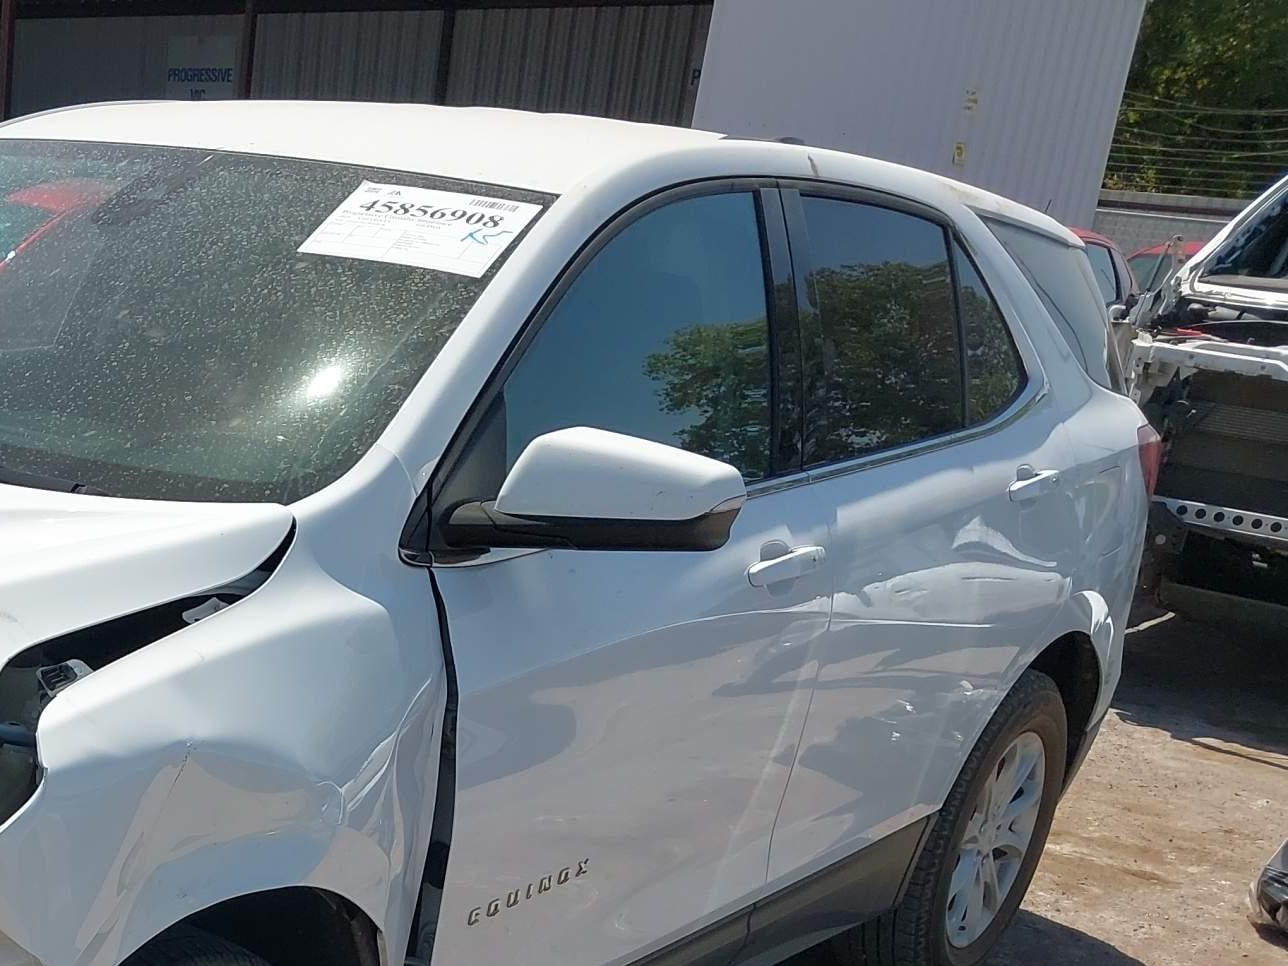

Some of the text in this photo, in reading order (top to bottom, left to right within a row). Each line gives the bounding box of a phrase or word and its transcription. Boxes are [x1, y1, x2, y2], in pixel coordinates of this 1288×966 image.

[167, 67, 233, 82] PROGRESSIVE
[359, 199, 505, 229] 45856908
[467, 858, 589, 926] EQUINOX
